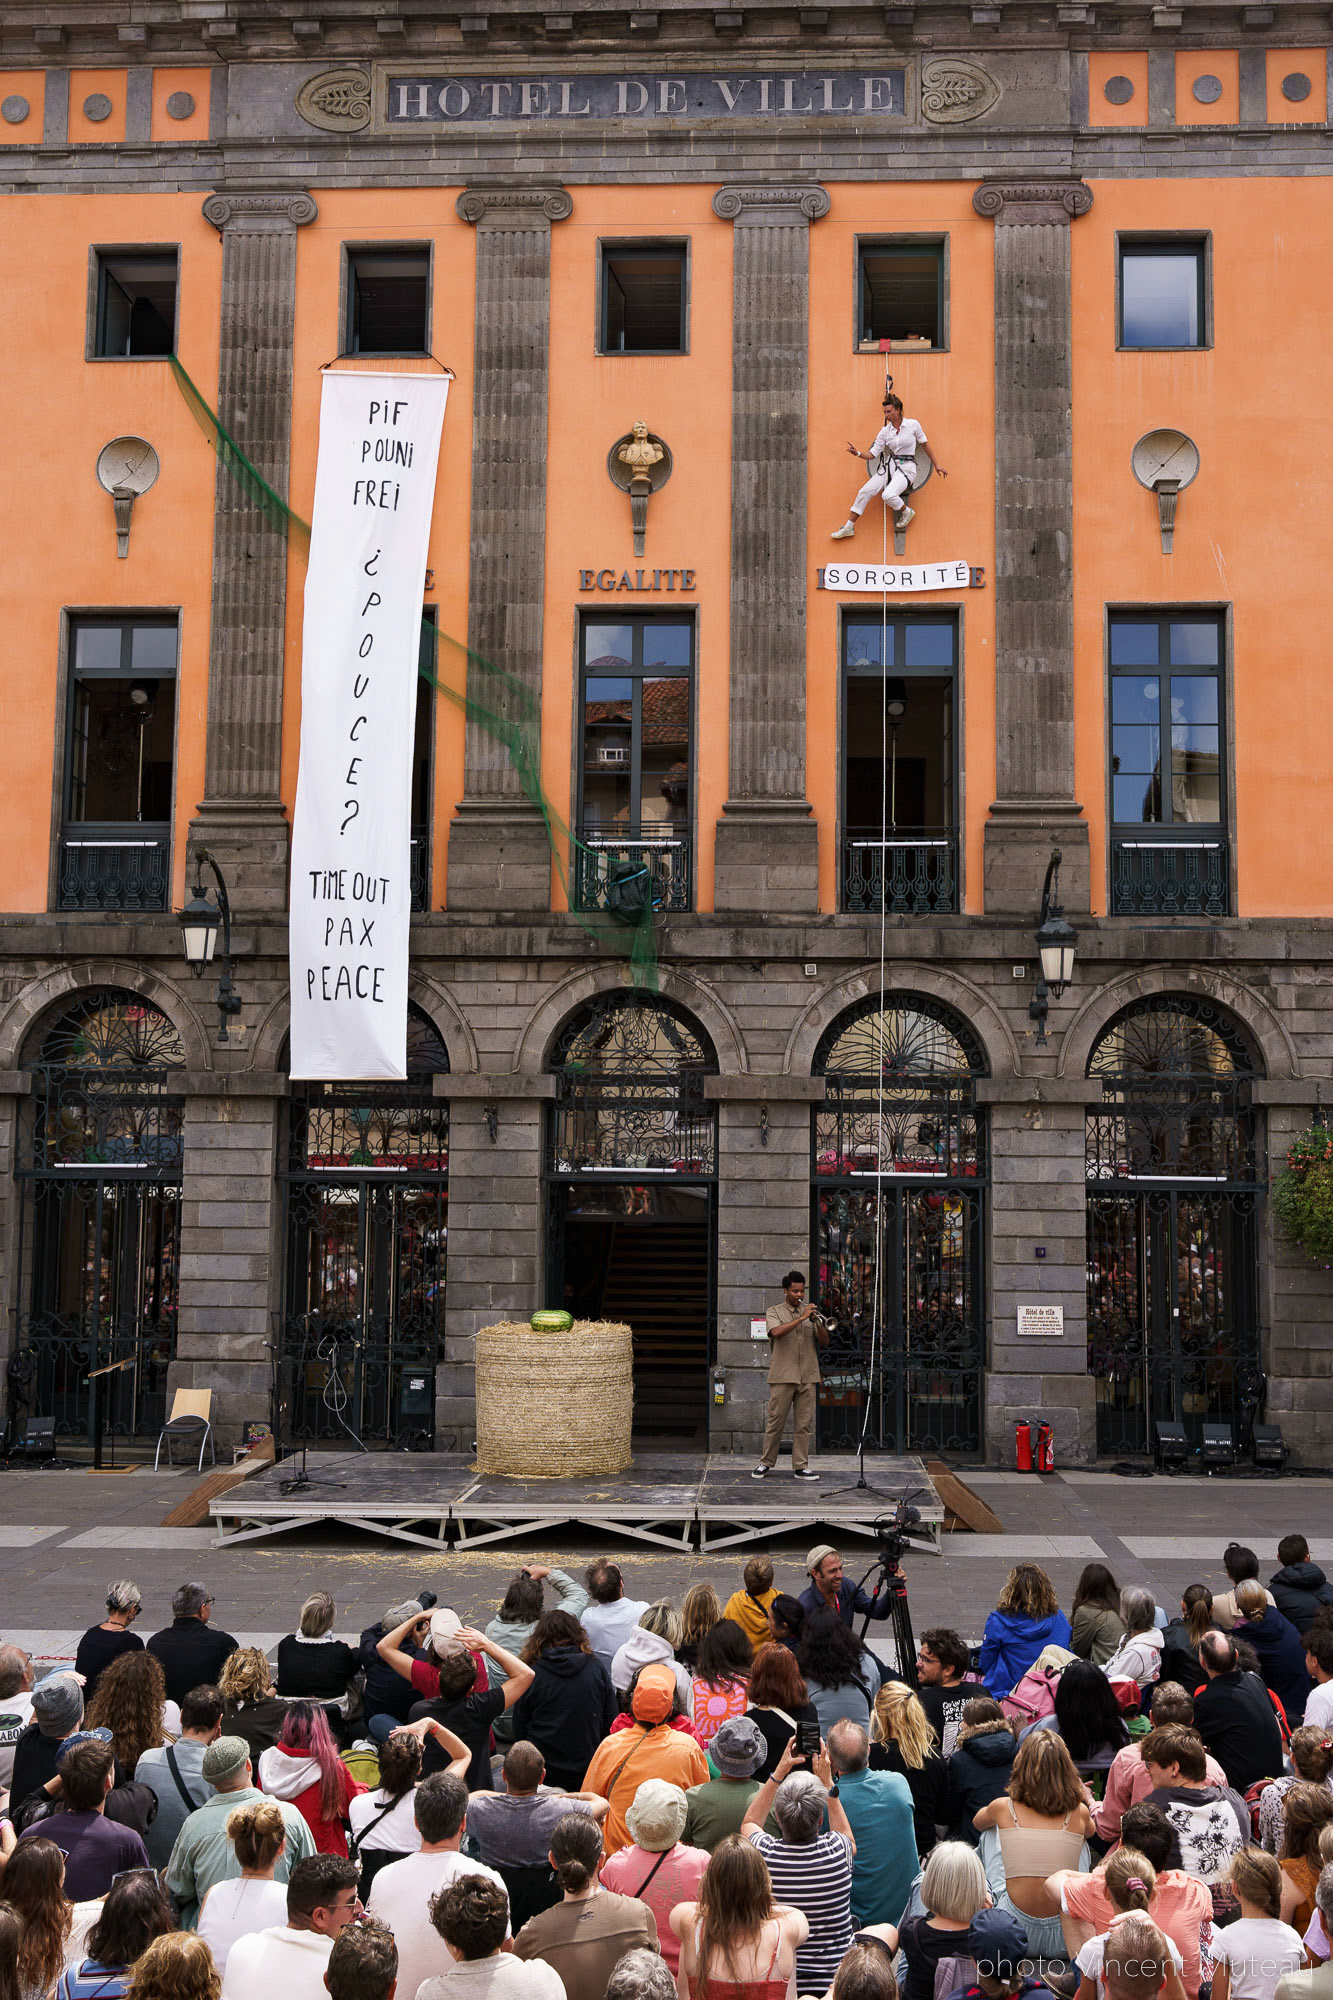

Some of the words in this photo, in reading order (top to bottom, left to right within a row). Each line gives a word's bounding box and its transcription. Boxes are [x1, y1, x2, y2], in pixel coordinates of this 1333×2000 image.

[394, 80, 590, 117] HÔTEL
[613, 81, 688, 114] DE
[711, 77, 893, 111] VILLE
[578, 569, 697, 591] EGALITE
[828, 563, 967, 586] SORORITÉ
[352, 872, 390, 905] OUT
[325, 917, 375, 947] PAX
[308, 965, 384, 1003] PEACE
